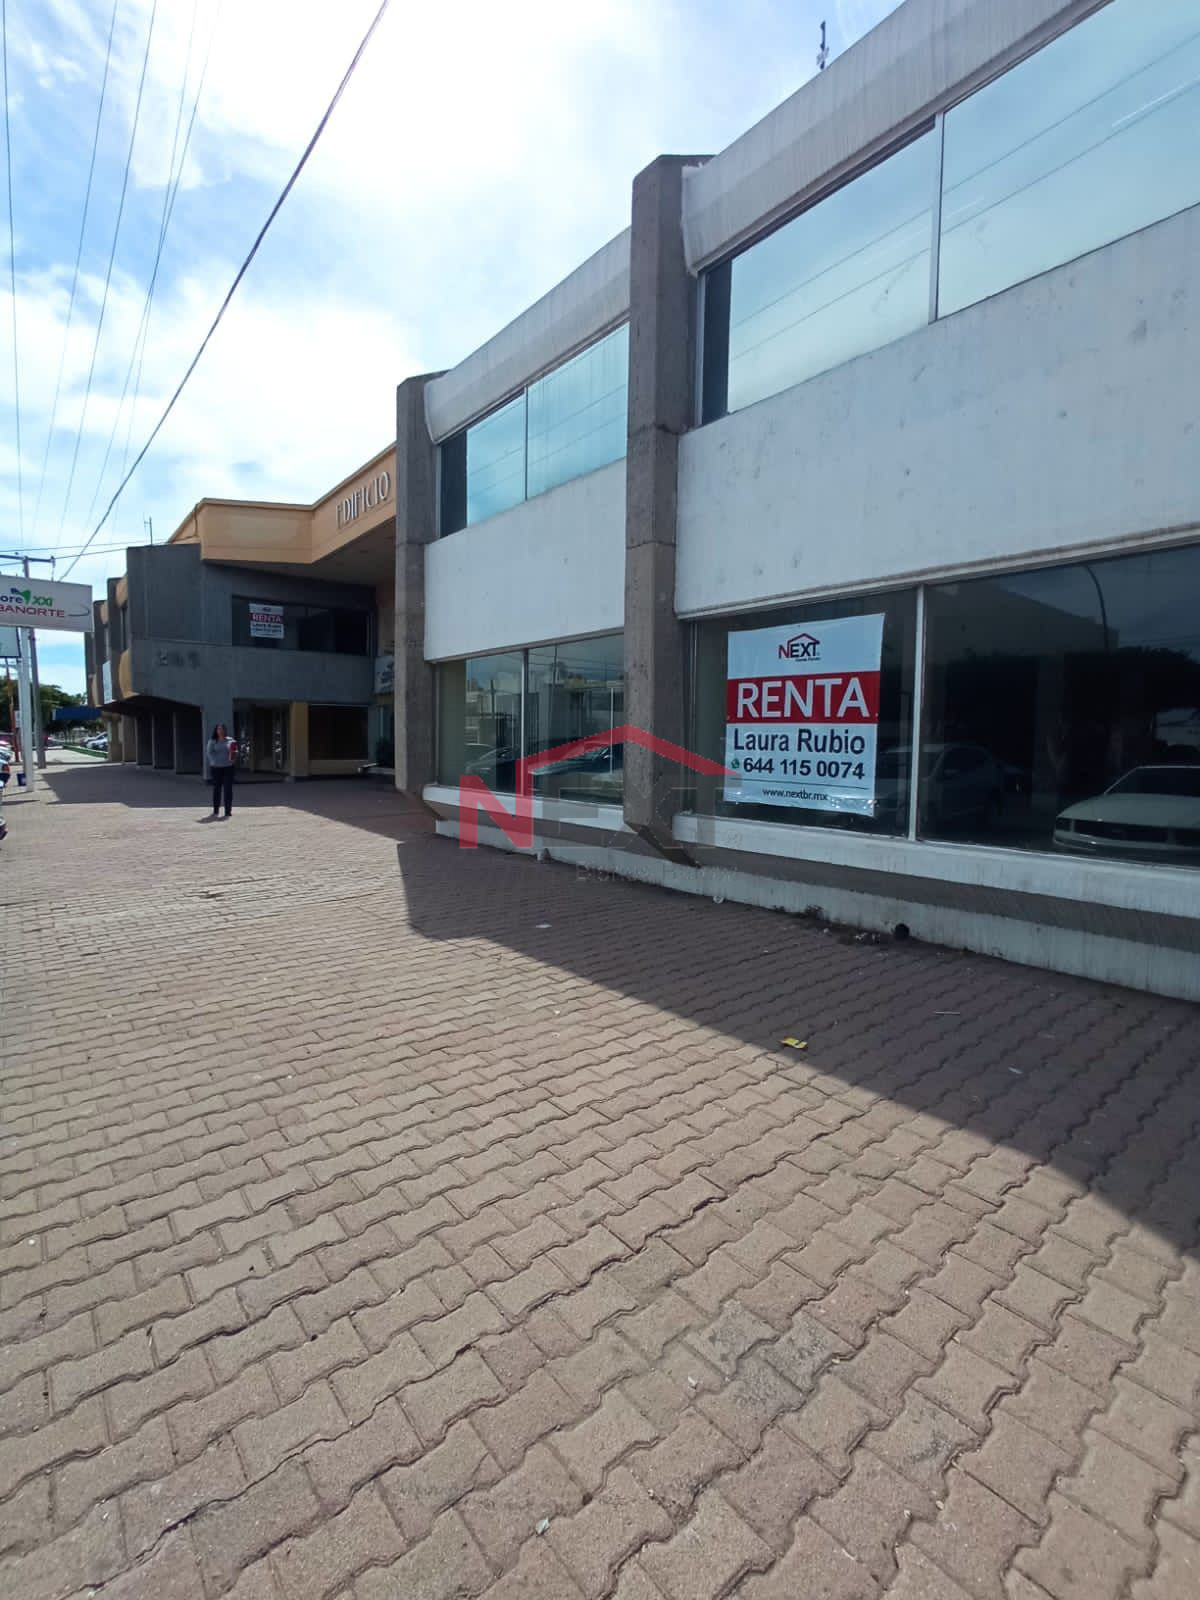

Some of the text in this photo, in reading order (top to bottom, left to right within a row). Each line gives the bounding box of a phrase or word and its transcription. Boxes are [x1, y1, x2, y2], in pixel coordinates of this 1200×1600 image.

[32, 595, 53, 607] XXI
[778, 639, 820, 659] NEXT
[736, 677, 870, 718] RENTA
[734, 728, 865, 754] Laura Rubio
[743, 757, 865, 780] 644 115 0074
[762, 788, 828, 801] www.nextbr.mx
